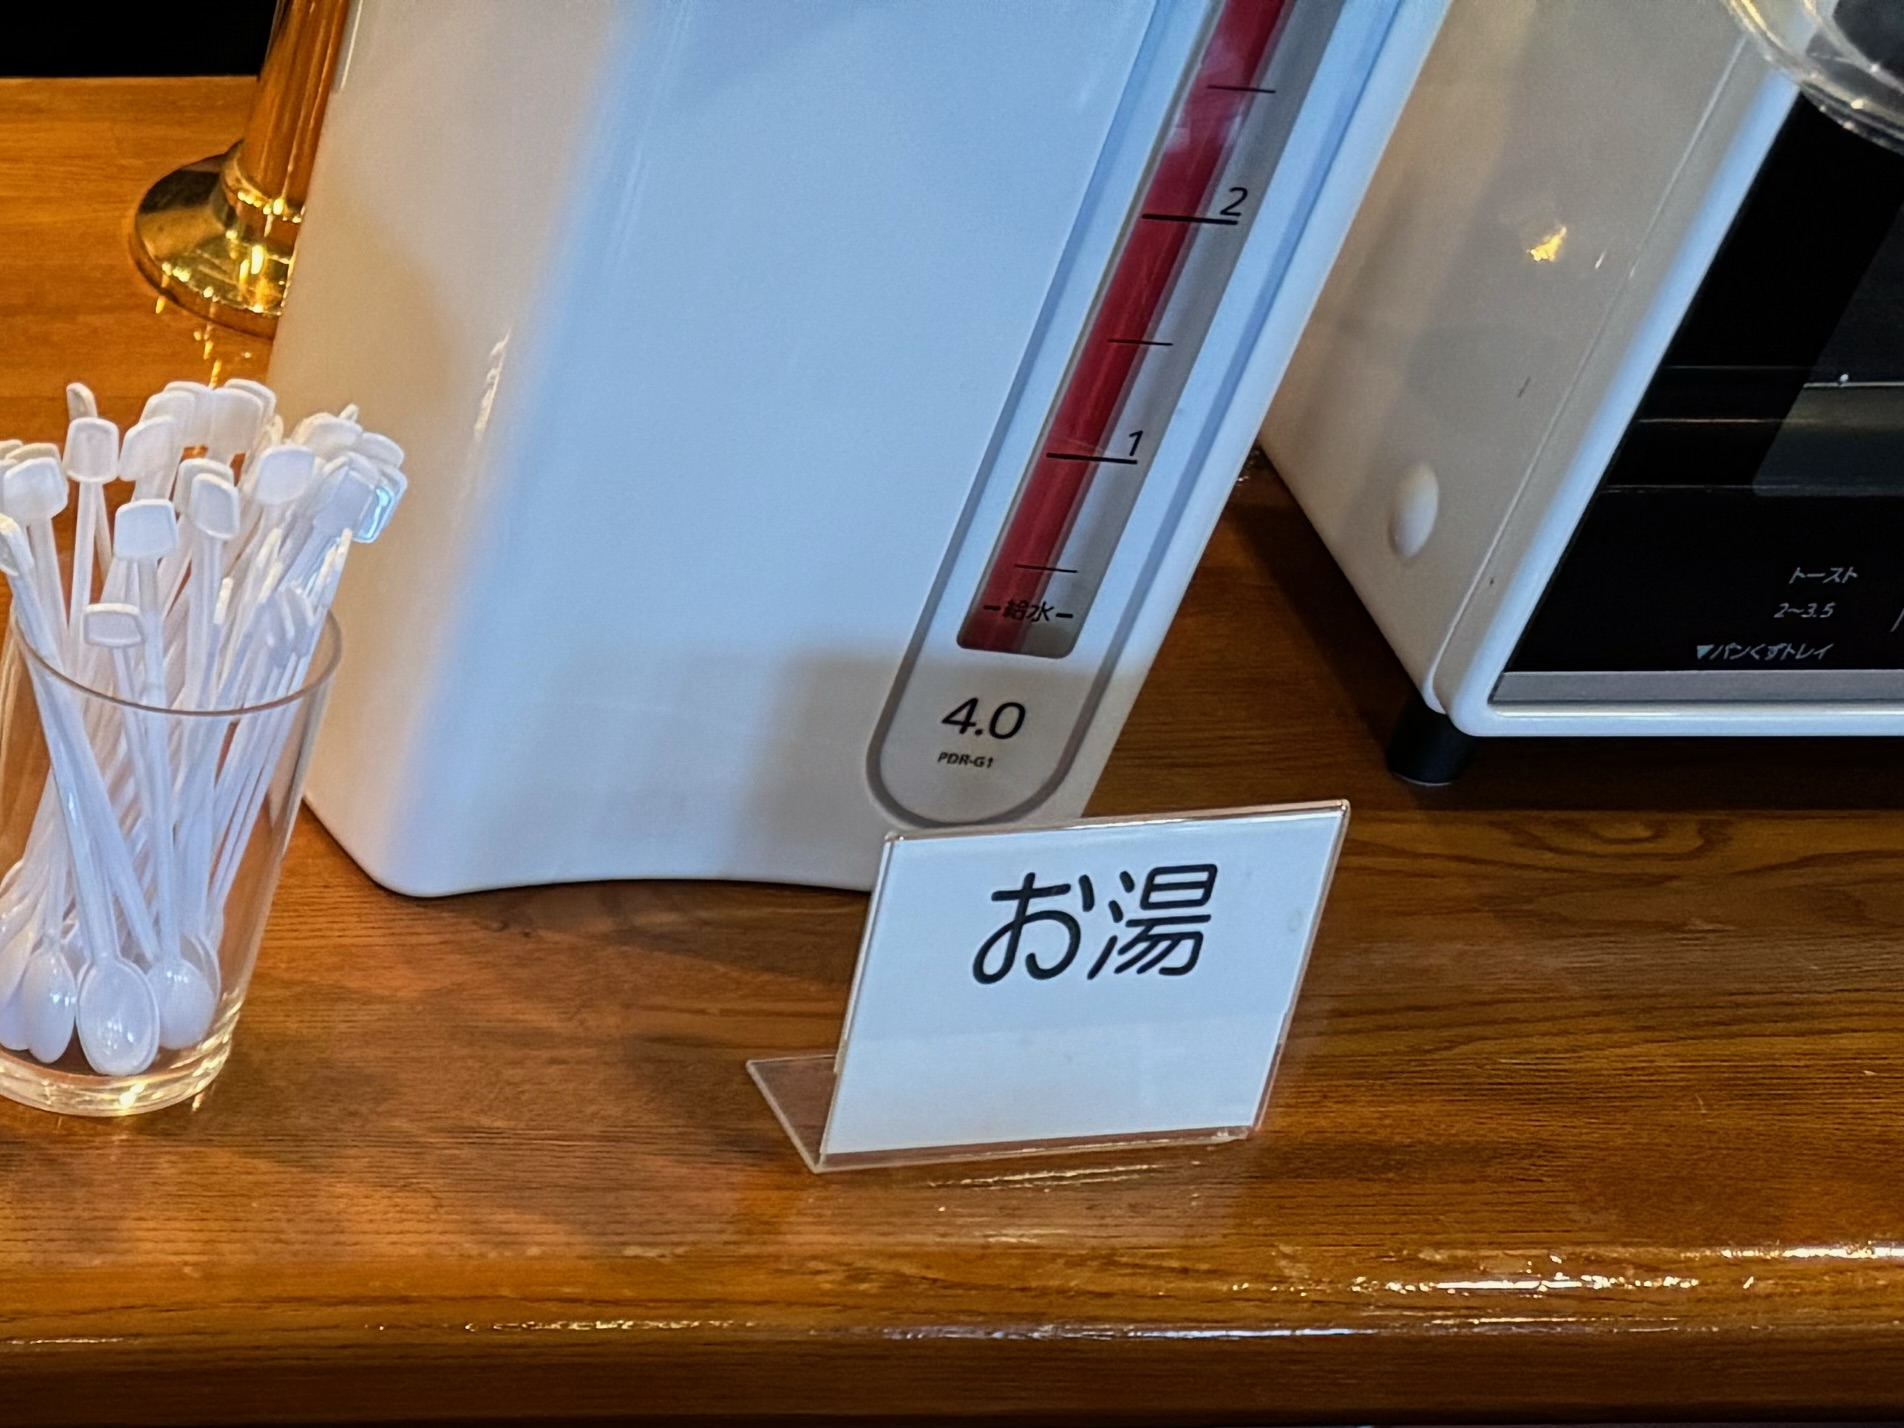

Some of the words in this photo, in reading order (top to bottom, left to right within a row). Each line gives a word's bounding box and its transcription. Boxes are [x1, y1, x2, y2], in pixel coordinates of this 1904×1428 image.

[1218, 186, 1248, 217] 2
[1125, 429, 1144, 457] 1
[1788, 566, 1859, 585] トースト
[941, 697, 1026, 740] 4.0
[971, 862, 1219, 986] お湯
